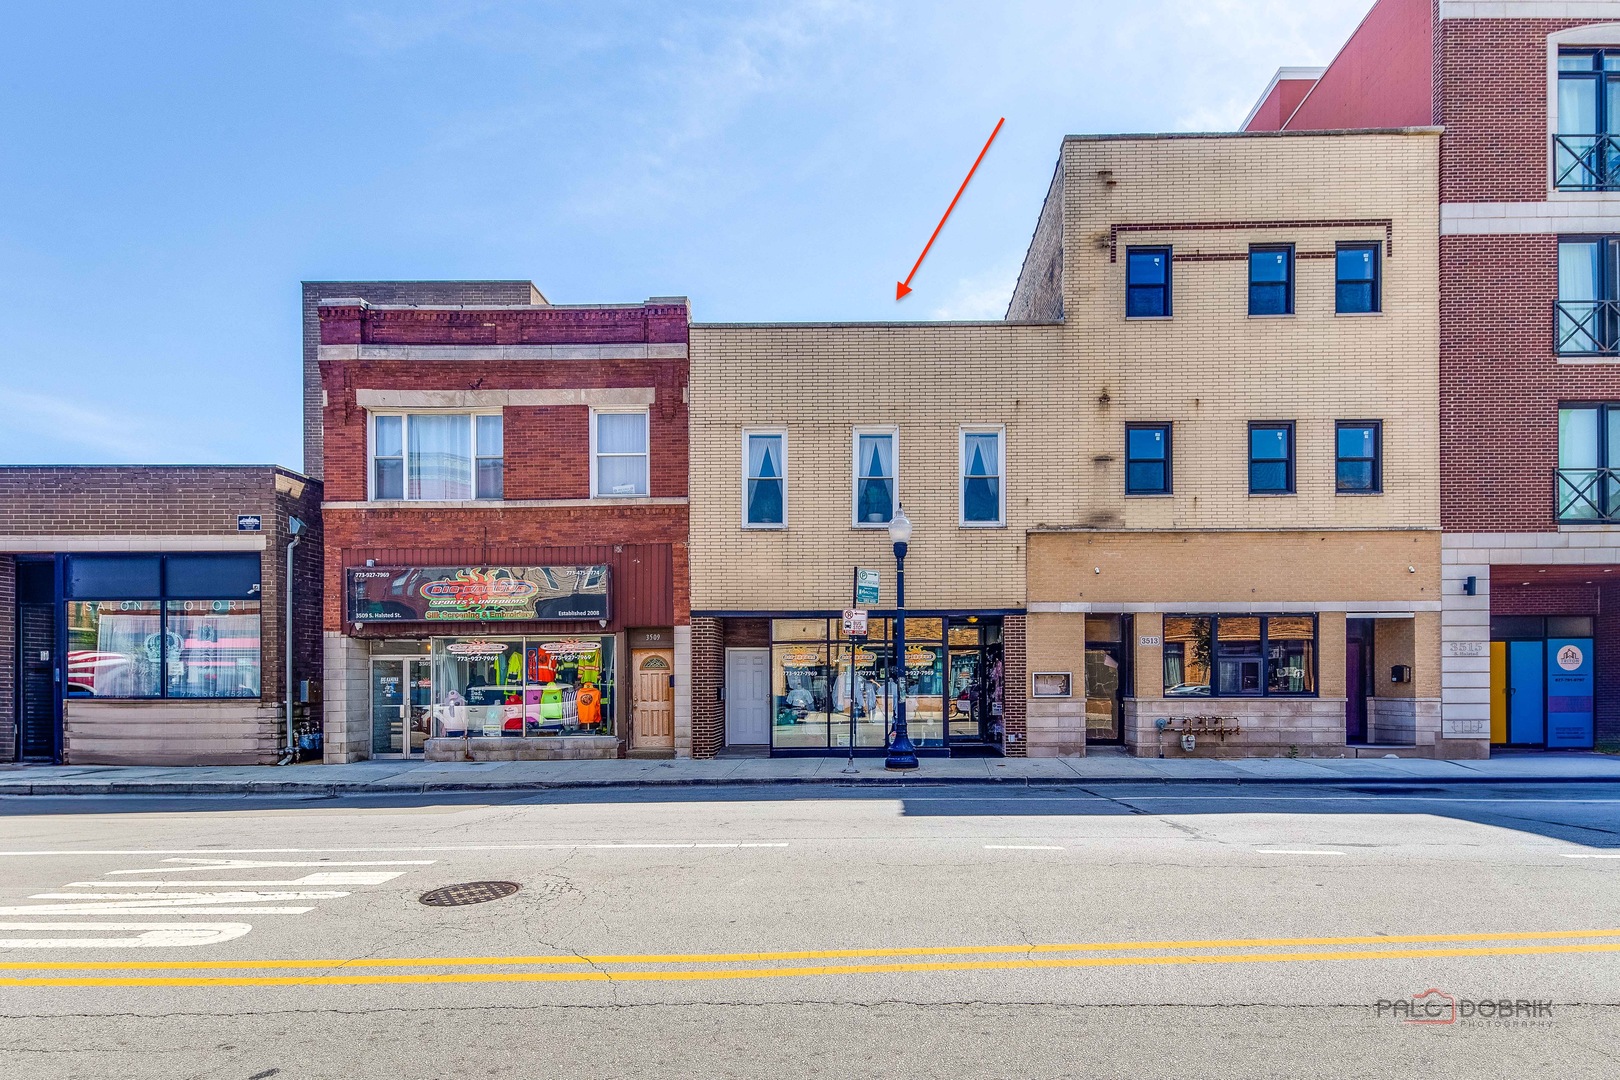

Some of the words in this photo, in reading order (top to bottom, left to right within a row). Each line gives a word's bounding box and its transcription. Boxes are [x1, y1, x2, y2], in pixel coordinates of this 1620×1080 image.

[431, 585, 460, 594] BIG
[85, 600, 142, 611] SALON
[184, 600, 246, 611] OLORI
[426, 611, 440, 619] Silk
[442, 611, 480, 620] Screening
[645, 633, 661, 641] 3509
[1141, 637, 1159, 645] 3513
[1449, 642, 1483, 652] 3515
